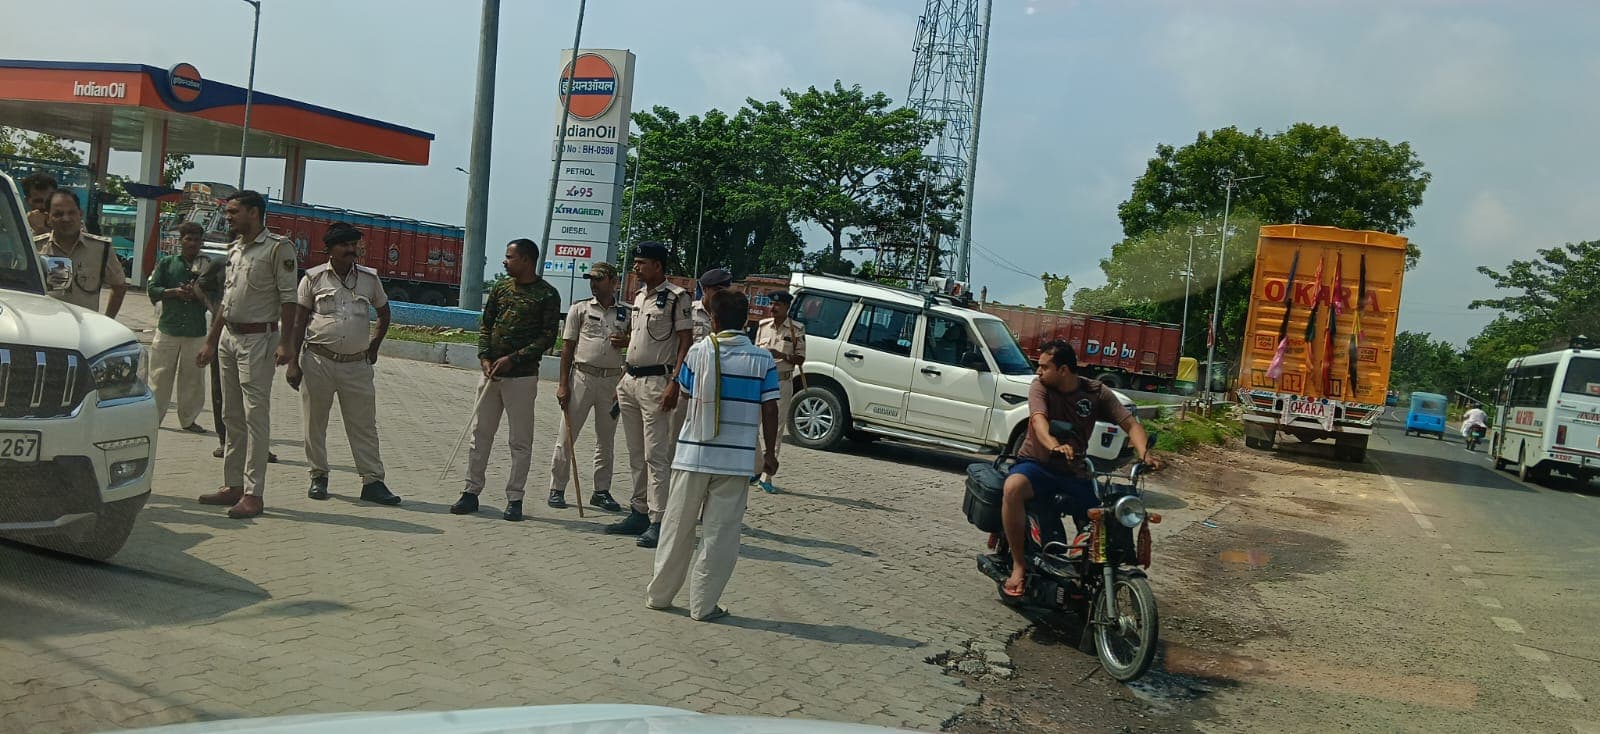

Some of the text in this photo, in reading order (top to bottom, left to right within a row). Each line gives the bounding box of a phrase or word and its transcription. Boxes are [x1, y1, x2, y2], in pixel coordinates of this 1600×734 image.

[73, 80, 126, 99] IndianOil
[556, 124, 616, 139] IdianOil
[582, 145, 614, 155] BH-0598
[566, 167, 595, 176] PETROL
[555, 203, 604, 216] XTRAGREEN
[561, 226, 588, 235] DIESEL
[557, 246, 586, 256] SERVO
[1290, 401, 1325, 417] OKARA
[0, 438, 37, 457] 267
